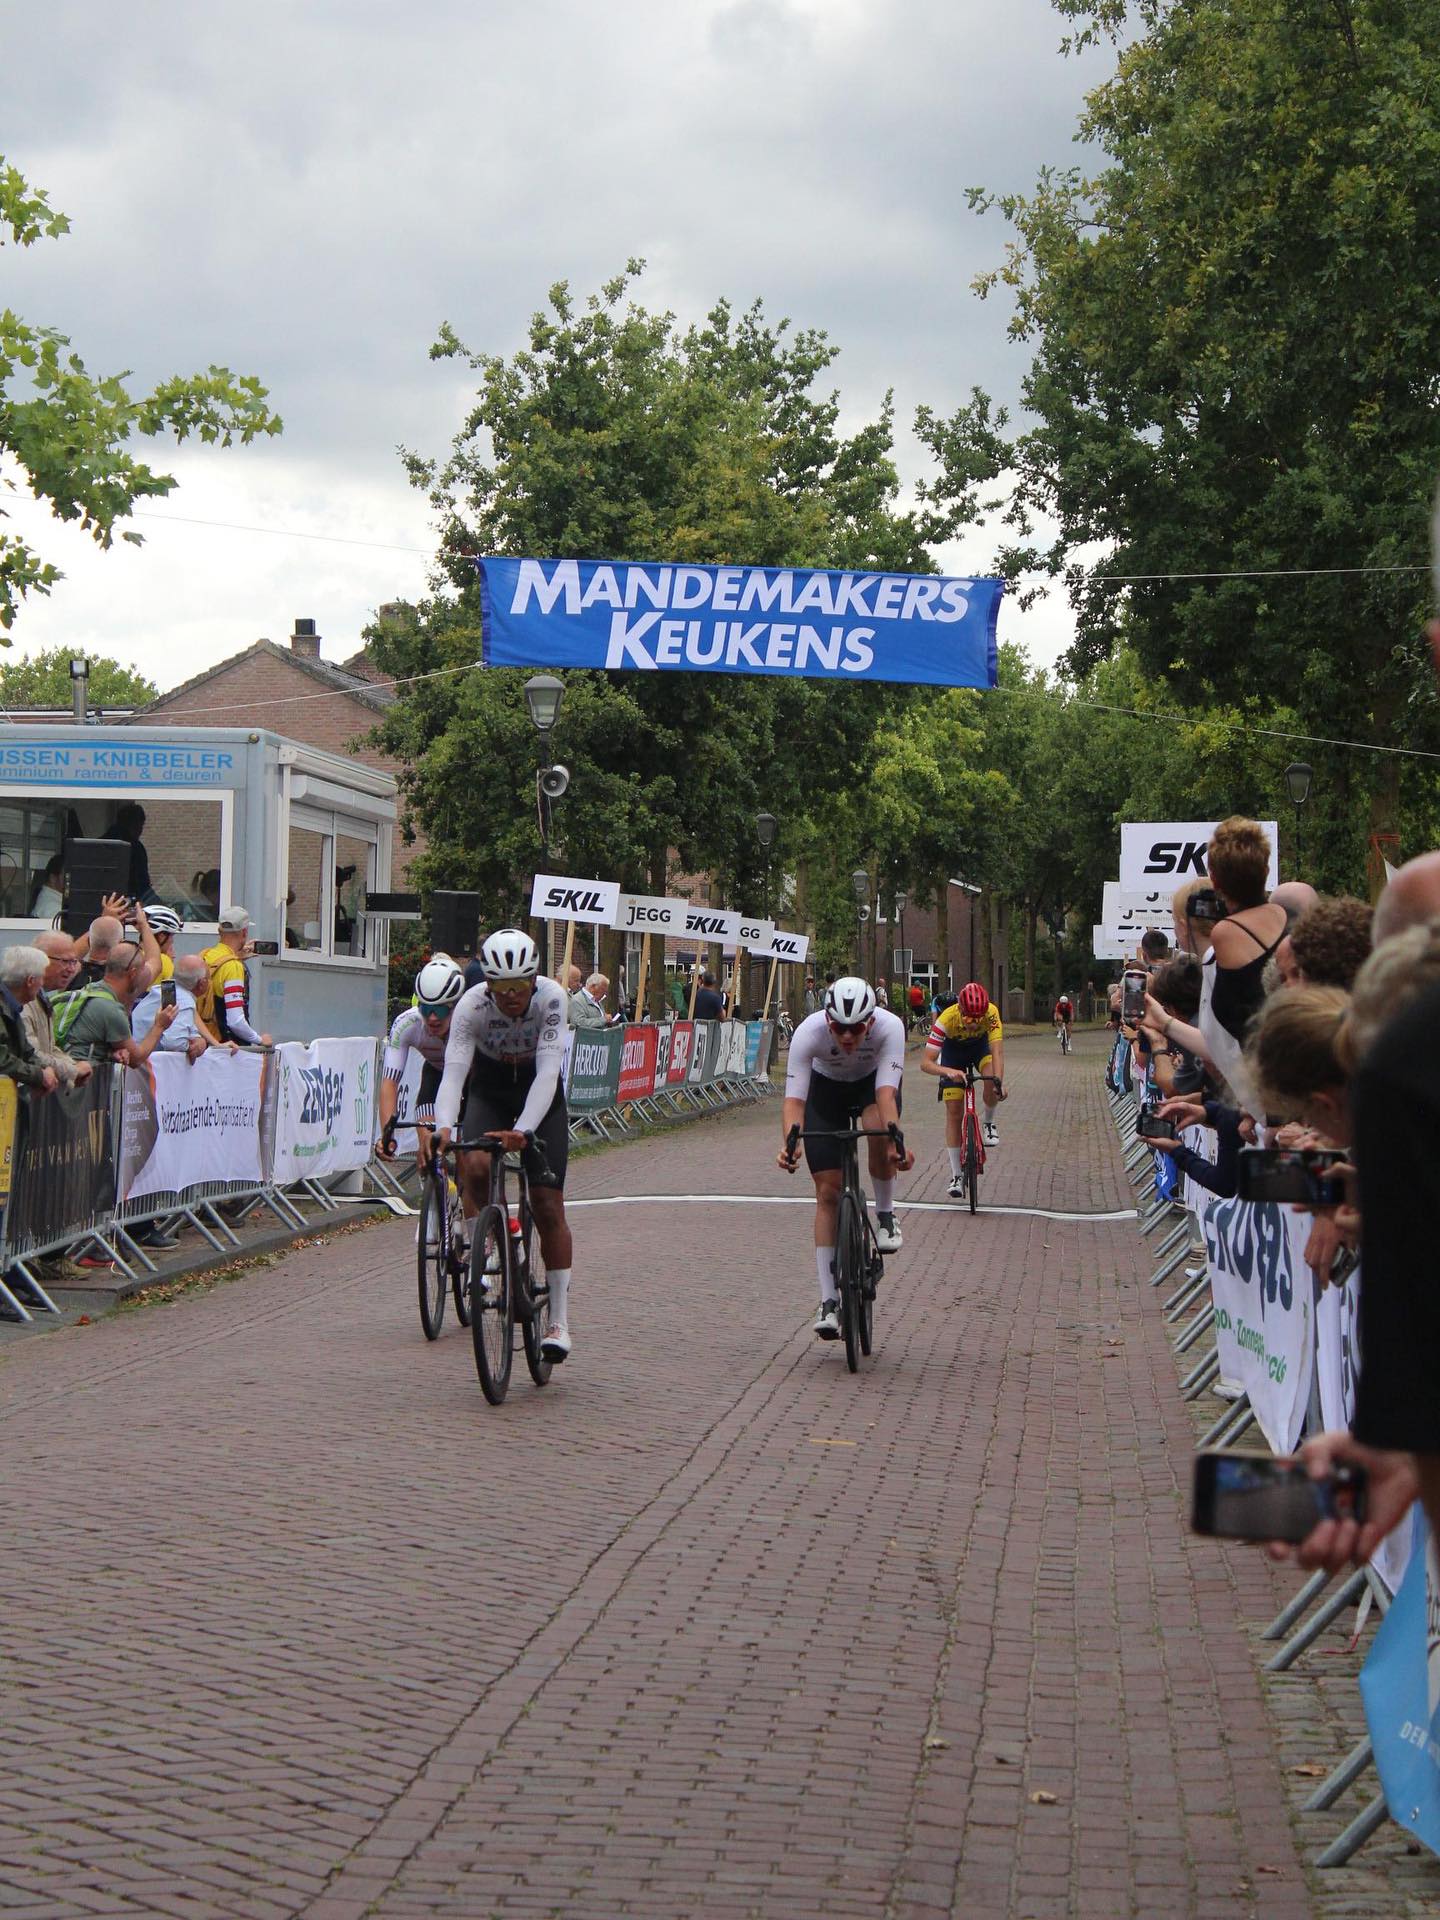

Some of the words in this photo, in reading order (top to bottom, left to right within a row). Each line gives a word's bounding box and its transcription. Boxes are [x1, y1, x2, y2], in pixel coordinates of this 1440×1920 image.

[509, 559, 974, 623] MANDEMAKERS
[604, 611, 876, 672] KEUKENS
[93, 751, 233, 769] KNIBBELER
[75, 768, 128, 780] ramen
[139, 767, 151, 780] &
[162, 767, 222, 781] deuren
[1143, 842, 1209, 876] SK
[544, 888, 605, 912] SKIL
[740, 927, 760, 939] GG
[771, 938, 798, 954] KIL
